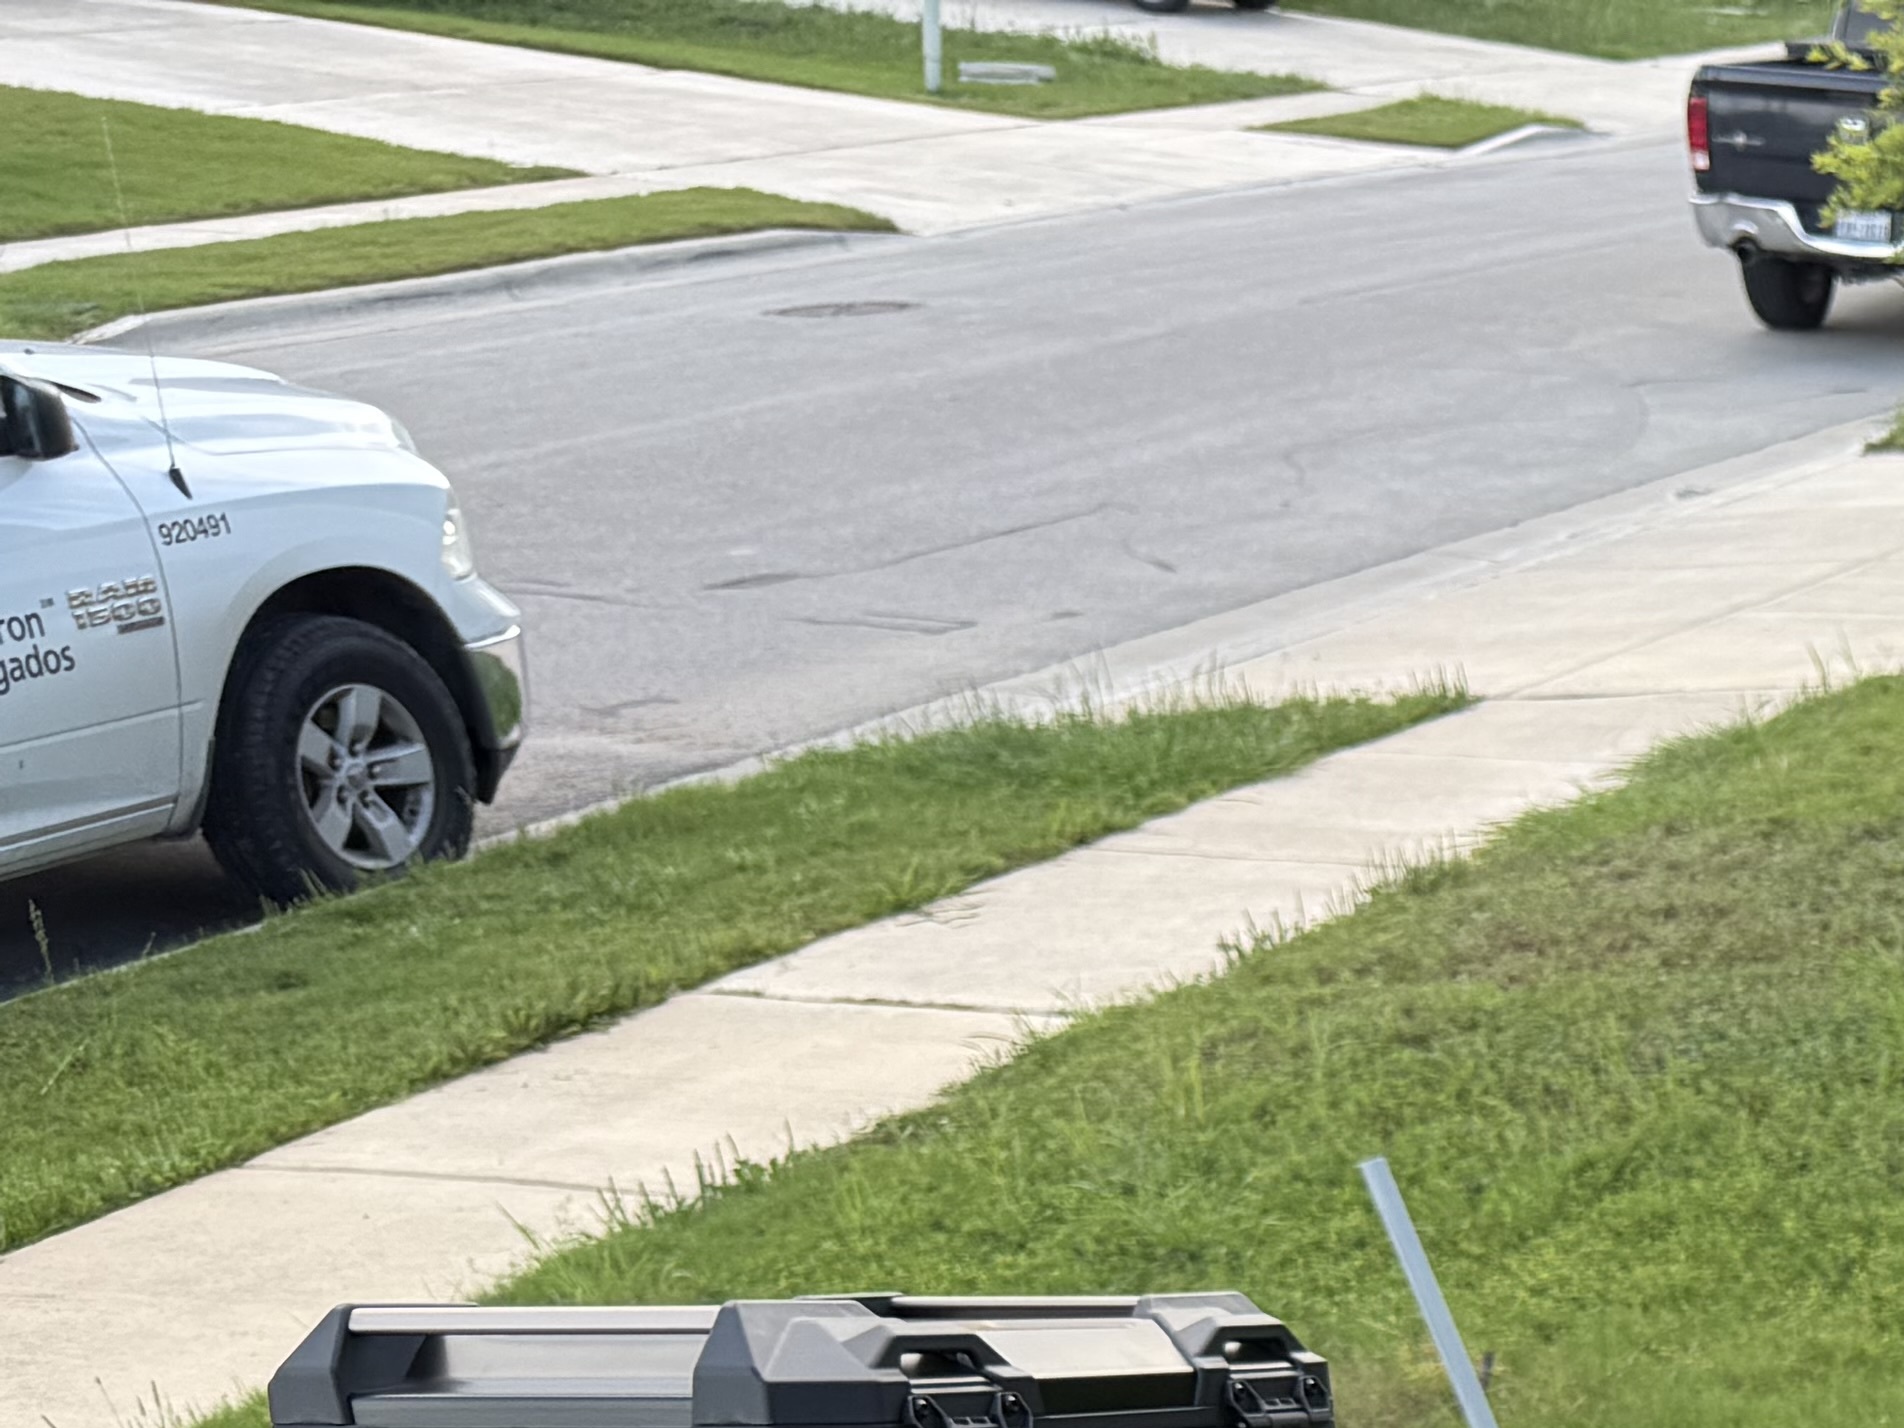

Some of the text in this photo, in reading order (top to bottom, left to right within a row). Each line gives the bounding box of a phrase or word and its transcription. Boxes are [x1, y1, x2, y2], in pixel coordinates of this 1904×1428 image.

[158, 512, 232, 546] 920491
[66, 575, 158, 609] RAM
[72, 597, 162, 630] 1500
